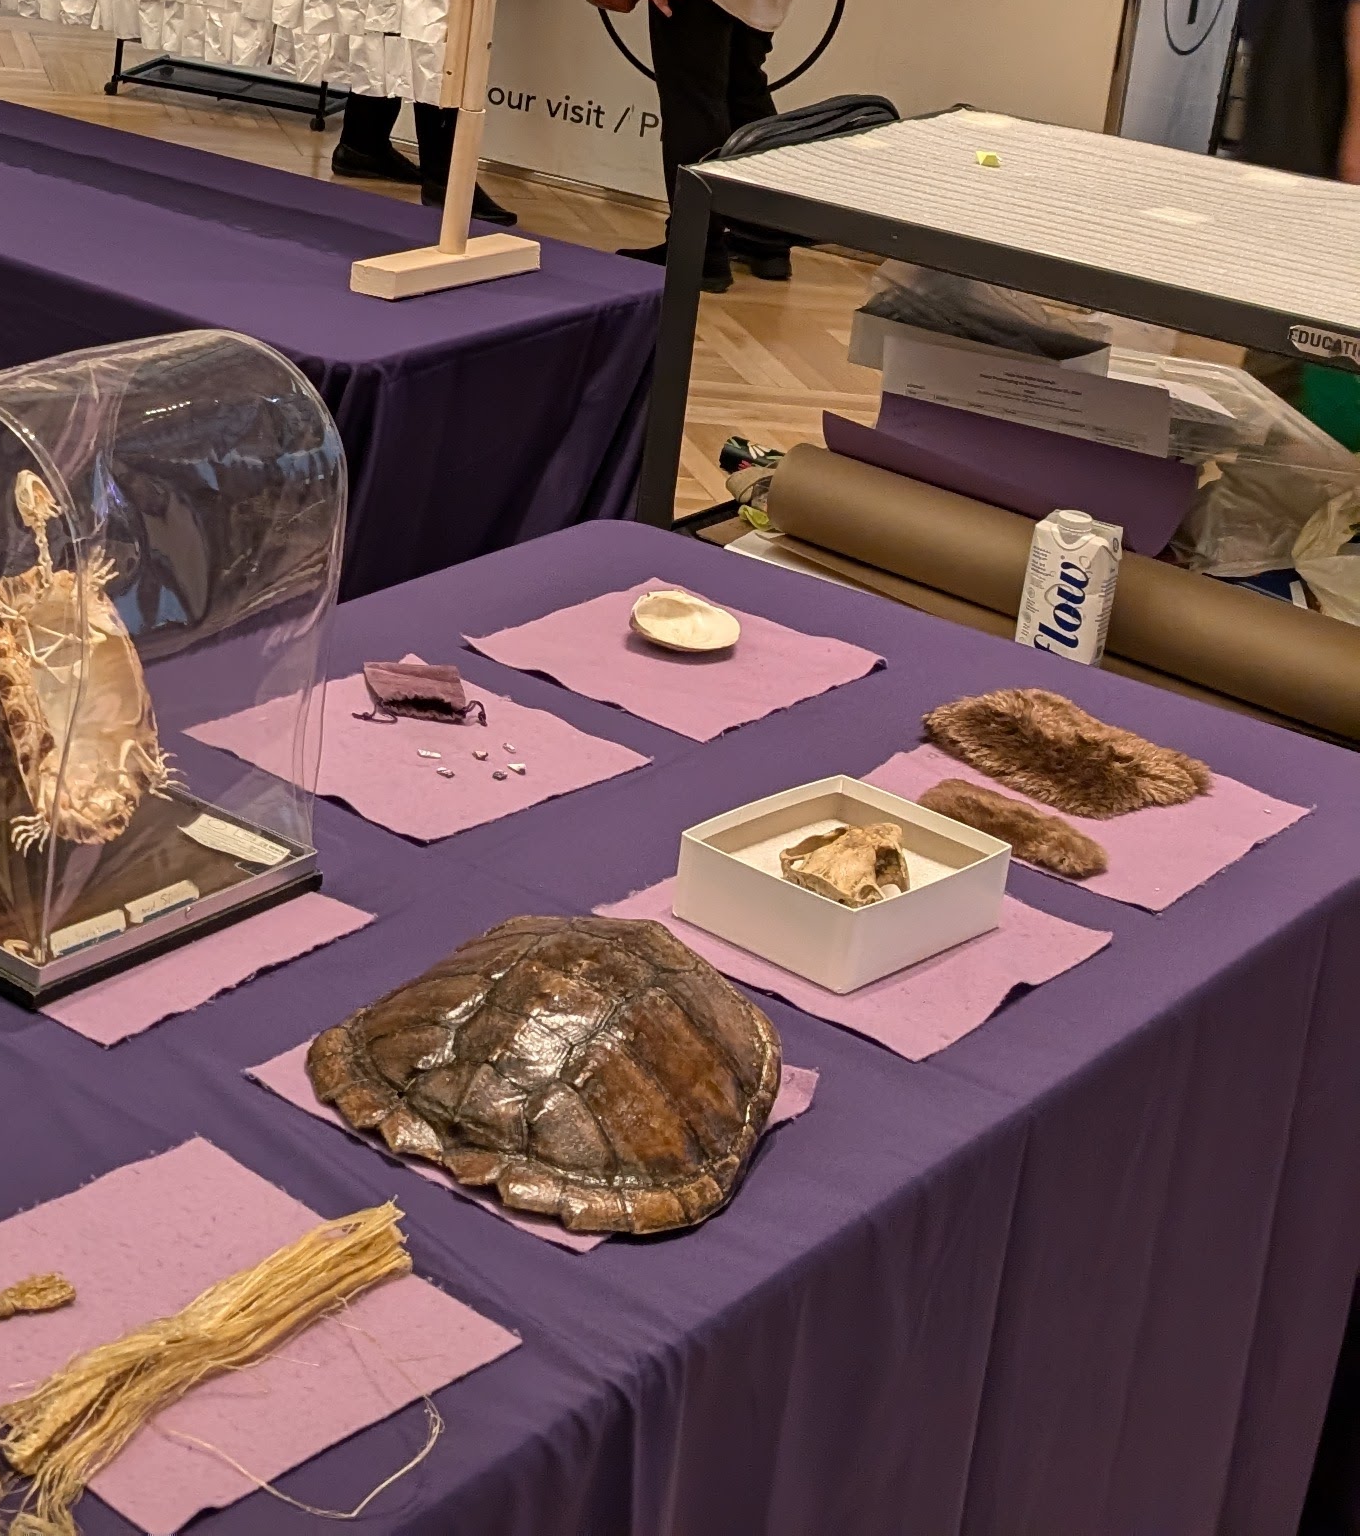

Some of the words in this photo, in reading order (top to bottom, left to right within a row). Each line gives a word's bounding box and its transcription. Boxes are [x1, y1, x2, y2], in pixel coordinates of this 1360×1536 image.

[487, 86, 536, 112] our
[546, 95, 605, 129] visit
[1289, 329, 1360, 357] EDUCATI
[1032, 561, 1090, 652] flow
